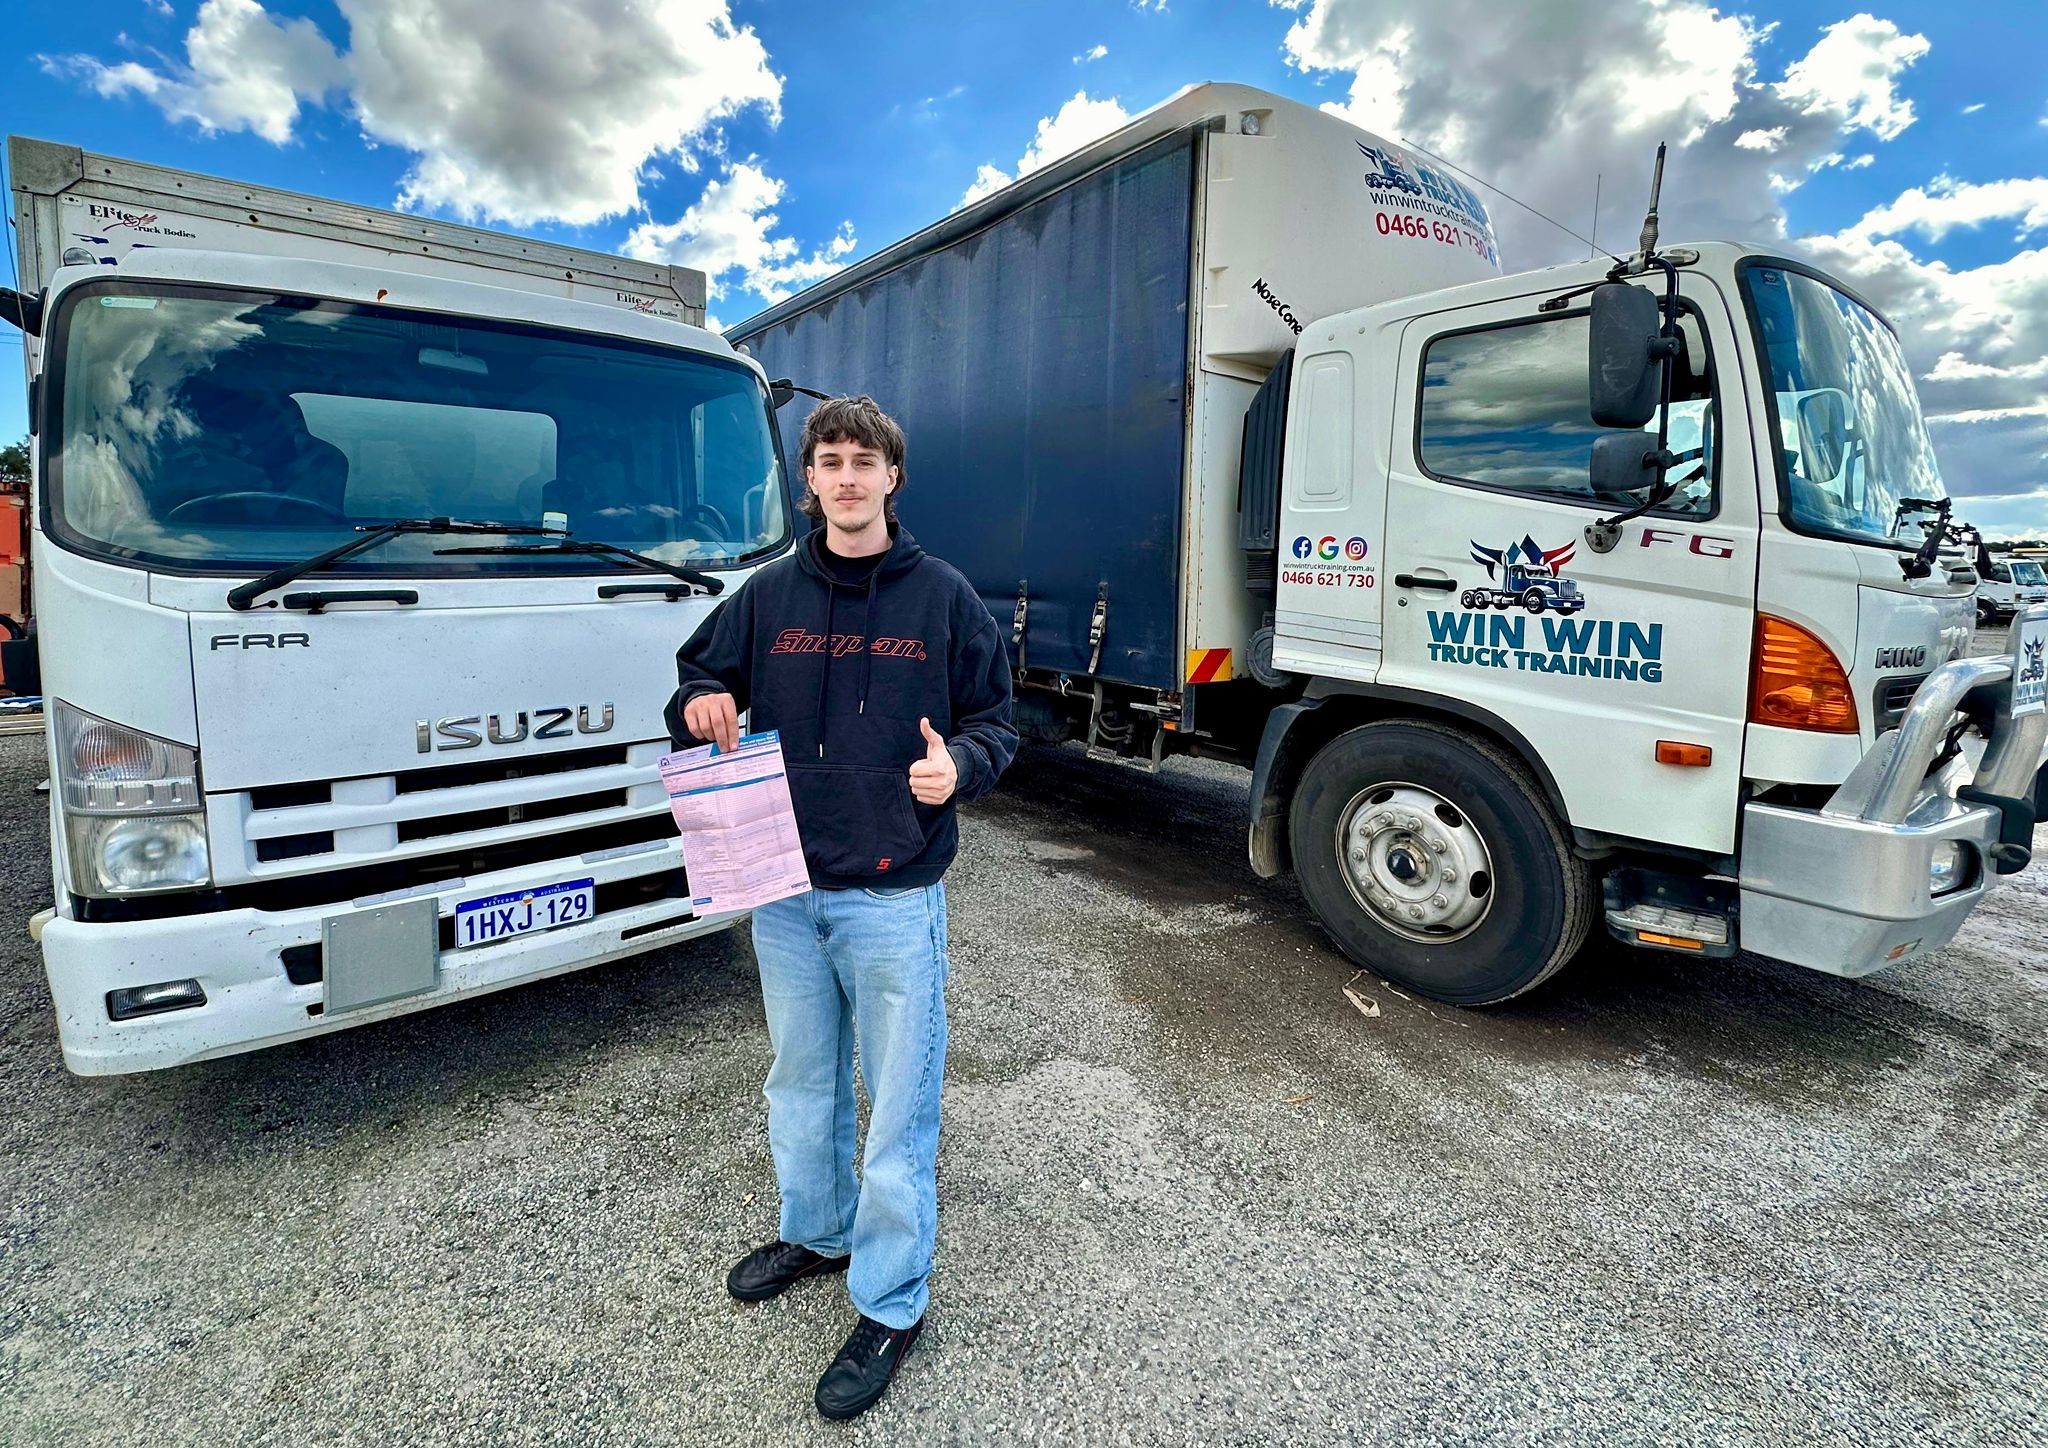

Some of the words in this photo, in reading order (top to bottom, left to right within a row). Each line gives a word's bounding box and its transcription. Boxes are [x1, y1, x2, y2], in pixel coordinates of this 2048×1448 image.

[163, 227, 196, 238] Bodies
[1375, 212, 1429, 239] 0466
[1432, 220, 1462, 247] 621
[1463, 230, 1488, 260] 730
[1250, 277, 1303, 336] NoseCone
[1640, 528, 1735, 559] FG
[1282, 571, 1313, 585] 0466
[1317, 573, 1342, 586] 621
[1347, 574, 1374, 588] 730
[1283, 561, 1375, 572] winwintrucktraining.com.au
[210, 632, 311, 651] FRR
[1426, 610, 1526, 649] WIN
[1541, 617, 1663, 660] WIN
[1427, 643, 1509, 668] TRUCK
[1514, 650, 1663, 683] TRAINING
[1875, 645, 1927, 669] HINO
[415, 701, 614, 754] ISUZU
[482, 897, 516, 907] WESTERN
[540, 886, 570, 896] AUSTRALIA
